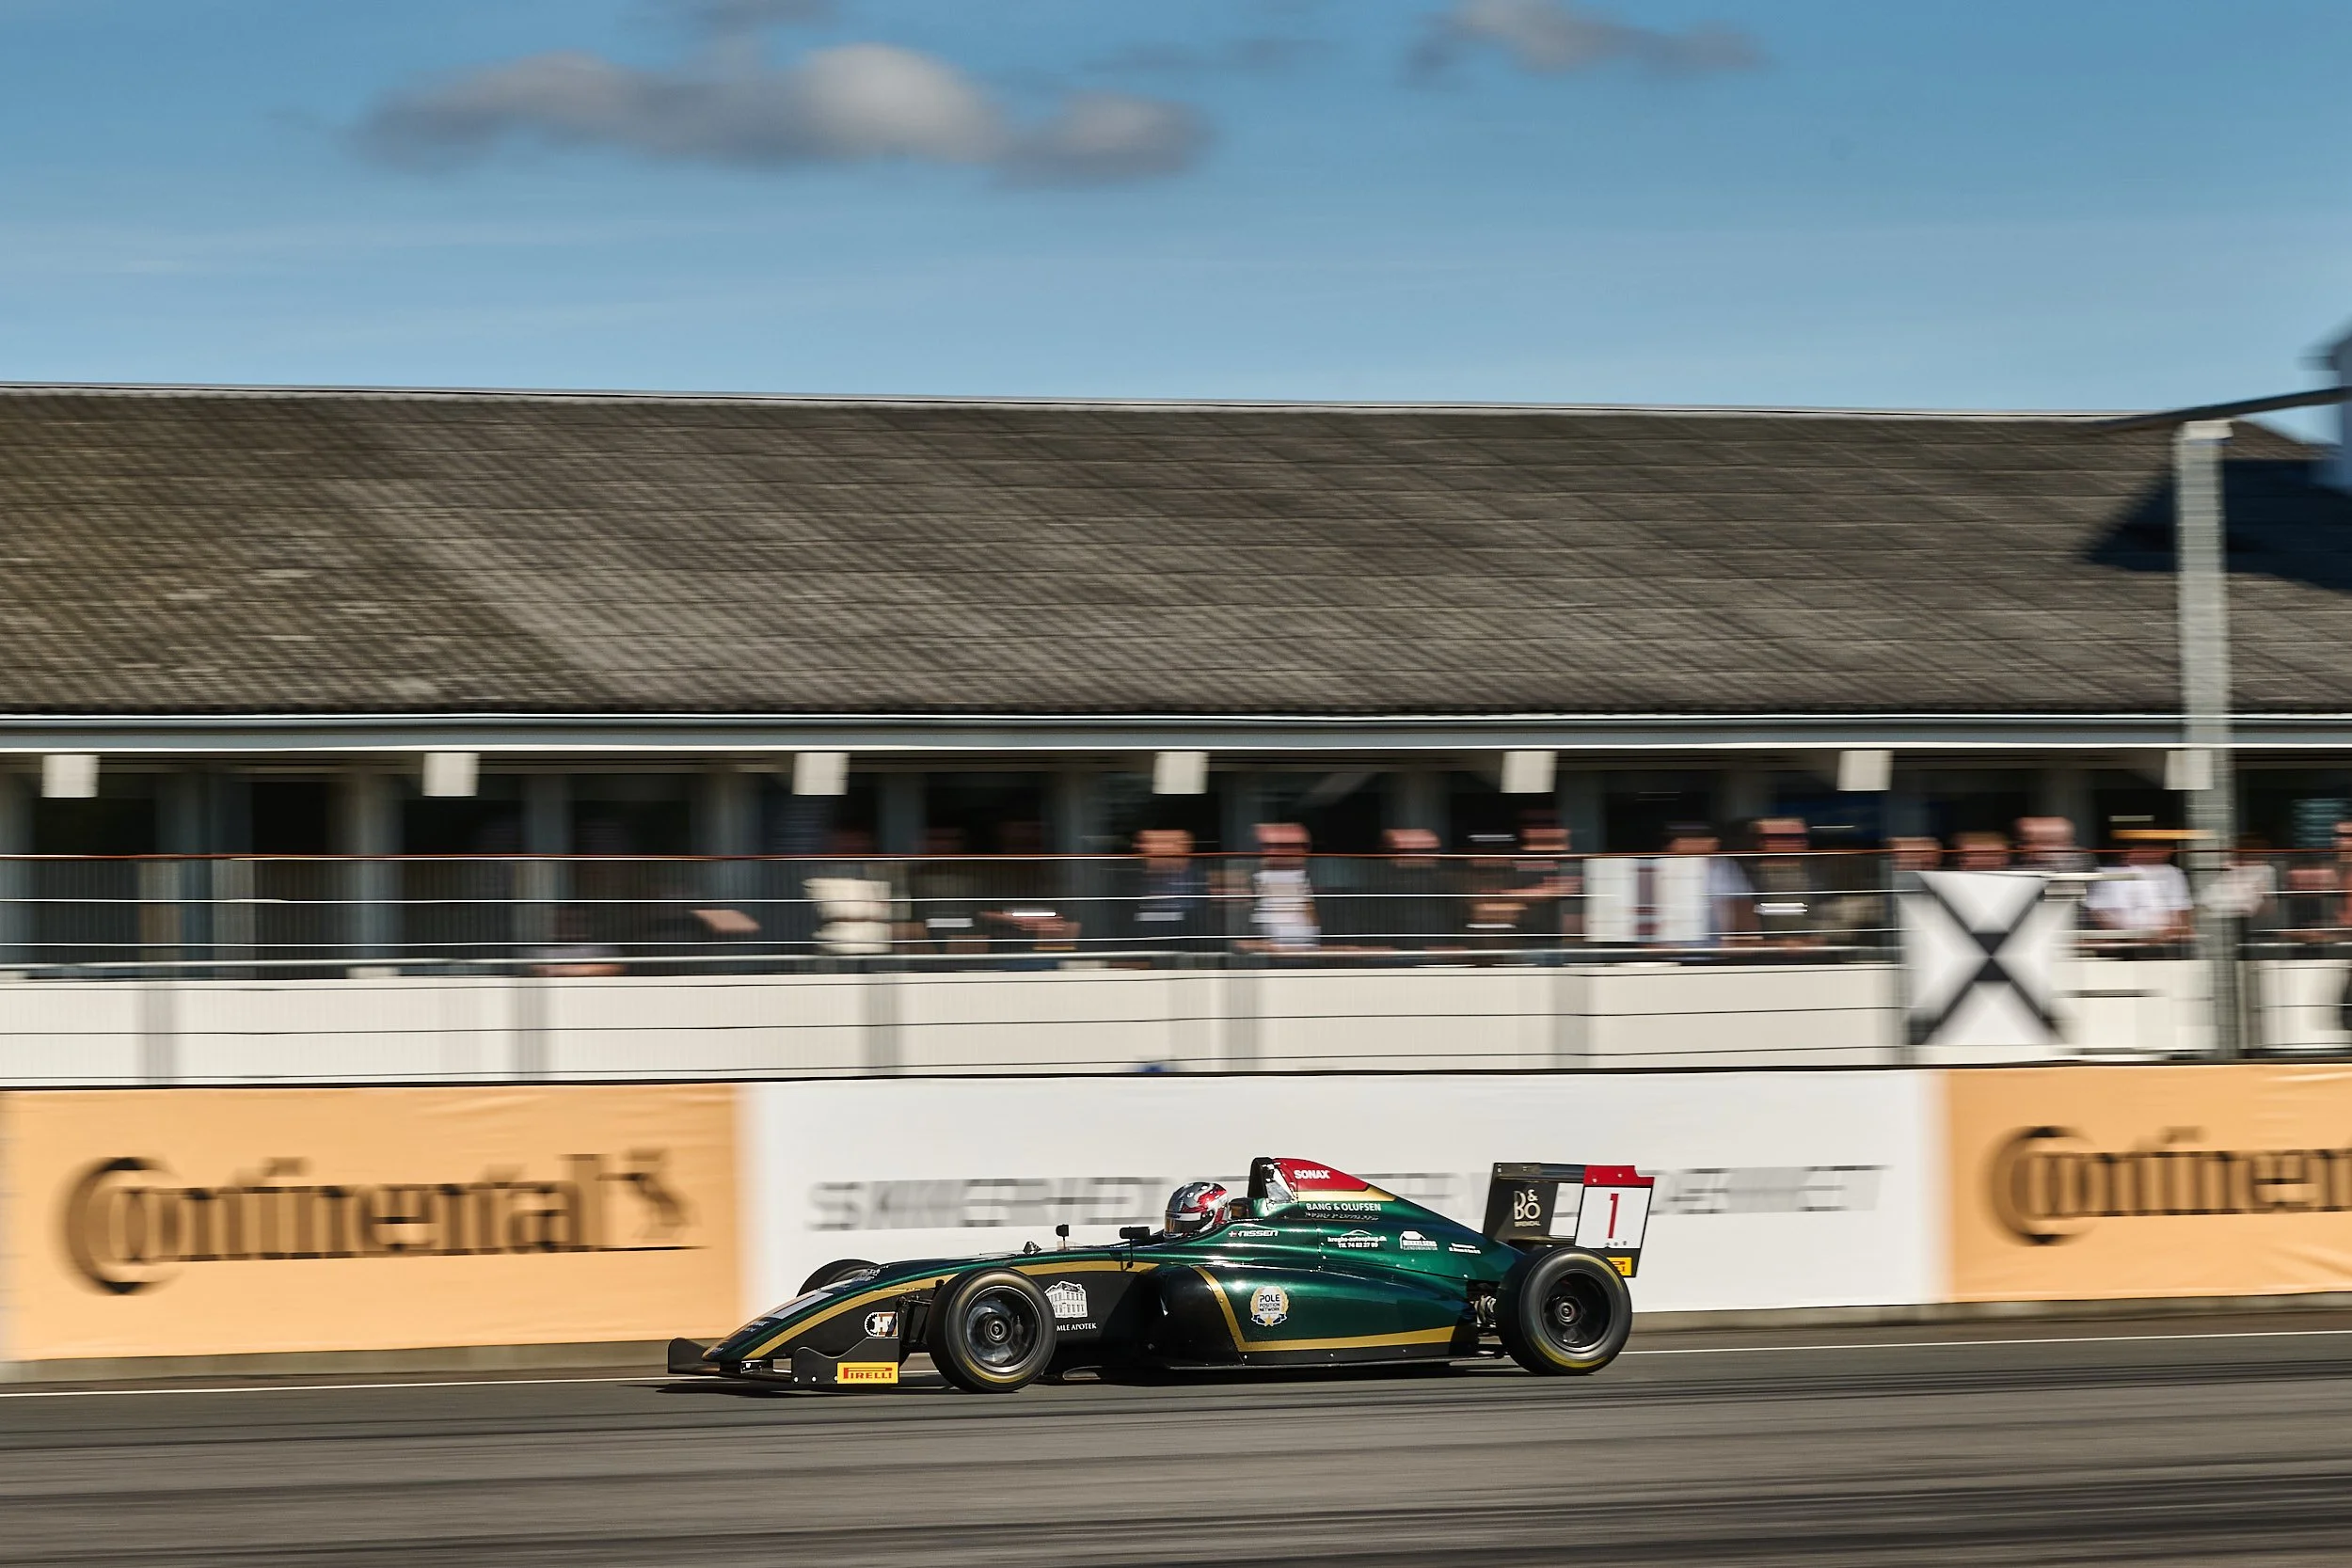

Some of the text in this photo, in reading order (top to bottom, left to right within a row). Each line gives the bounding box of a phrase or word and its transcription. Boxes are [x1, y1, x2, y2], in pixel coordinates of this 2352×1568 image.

[1294, 1169, 1330, 1180] SONAX
[1306, 1203, 1382, 1212] BANG & OLUFSEN
[1608, 1193, 1619, 1239] 1
[1259, 1294, 1280, 1303] POLE
[843, 1367, 893, 1380] PIRELLI
